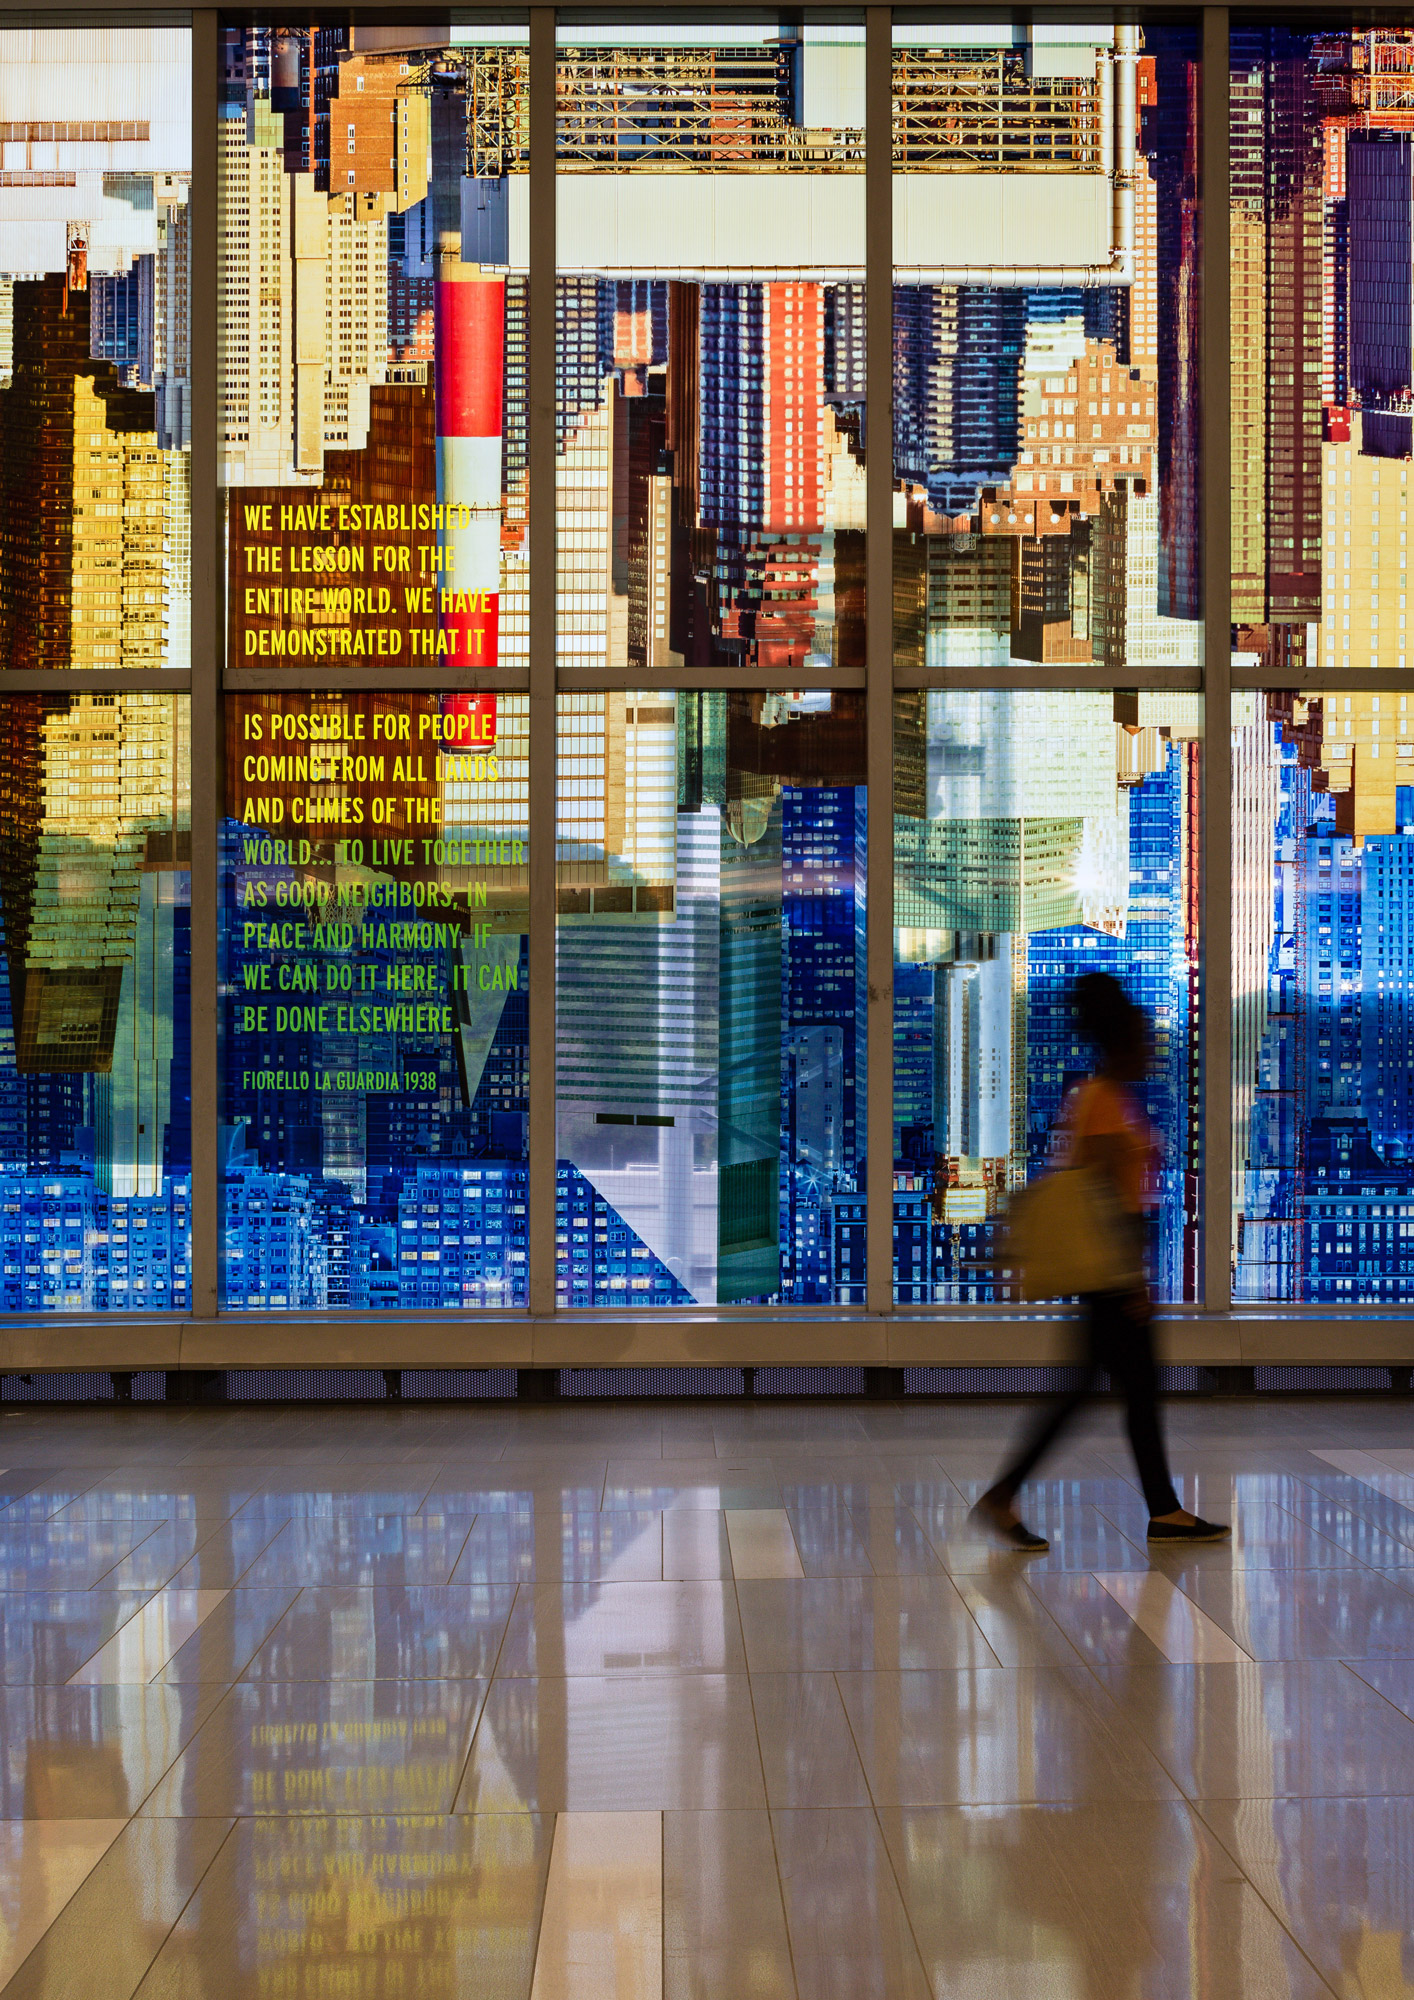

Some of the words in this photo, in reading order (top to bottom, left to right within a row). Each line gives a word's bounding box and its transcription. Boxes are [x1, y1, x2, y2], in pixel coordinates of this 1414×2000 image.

[244, 504, 273, 531] WE
[281, 504, 331, 531] HAVE
[339, 504, 470, 531] ESTABLISHED
[244, 545, 283, 573] THE
[290, 545, 364, 573] LESSON
[373, 545, 411, 573] FOR
[417, 545, 456, 573] THE
[245, 587, 315, 614] ENTIRE
[322, 587, 397, 614] WORLD.
[404, 587, 433, 614] WE
[441, 587, 492, 614] HAVE
[245, 628, 402, 656] DEMONSTRATED
[409, 628, 460, 656] THAT
[467, 628, 485, 656] IT
[244, 714, 263, 740] IS
[271, 714, 365, 740] POSSIBLE
[373, 714, 411, 740] FOR
[419, 714, 499, 743] PEOPLE,
[243, 755, 322, 782] COMING
[330, 755, 385, 782] FROM
[392, 755, 427, 782] ALL
[435, 755, 499, 782] LANDS
[243, 797, 284, 824] AND
[291, 797, 364, 824] CLIMES
[371, 797, 396, 824] OF
[403, 797, 442, 824] THE
[243, 839, 332, 866] WORLD...
[339, 839, 364, 866] TO
[372, 839, 414, 866] LIVE
[421, 839, 524, 866] TOGETHER
[243, 881, 268, 907] AS
[275, 881, 329, 907] GOOD
[337, 881, 458, 910] NEIGHBORS,
[467, 881, 487, 907] IN
[243, 922, 306, 949] PEACE
[313, 922, 353, 949] AND
[362, 922, 465, 949] HARMONY.
[474, 922, 493, 949] IF
[243, 964, 271, 991] WE
[278, 964, 318, 991] CAN
[327, 964, 352, 991] DO
[361, 964, 379, 991] IT
[386, 964, 444, 994] HERE,
[453, 964, 471, 991] IT
[478, 964, 518, 991] CAN
[243, 1006, 268, 1033] BE
[276, 1006, 329, 1033] DONE
[337, 1006, 460, 1033] ELSEWHERE.
[243, 1071, 309, 1091] FIORELLO
[315, 1071, 331, 1091] LA
[336, 1071, 399, 1091] GUARDIA
[403, 1071, 437, 1091] 1938
